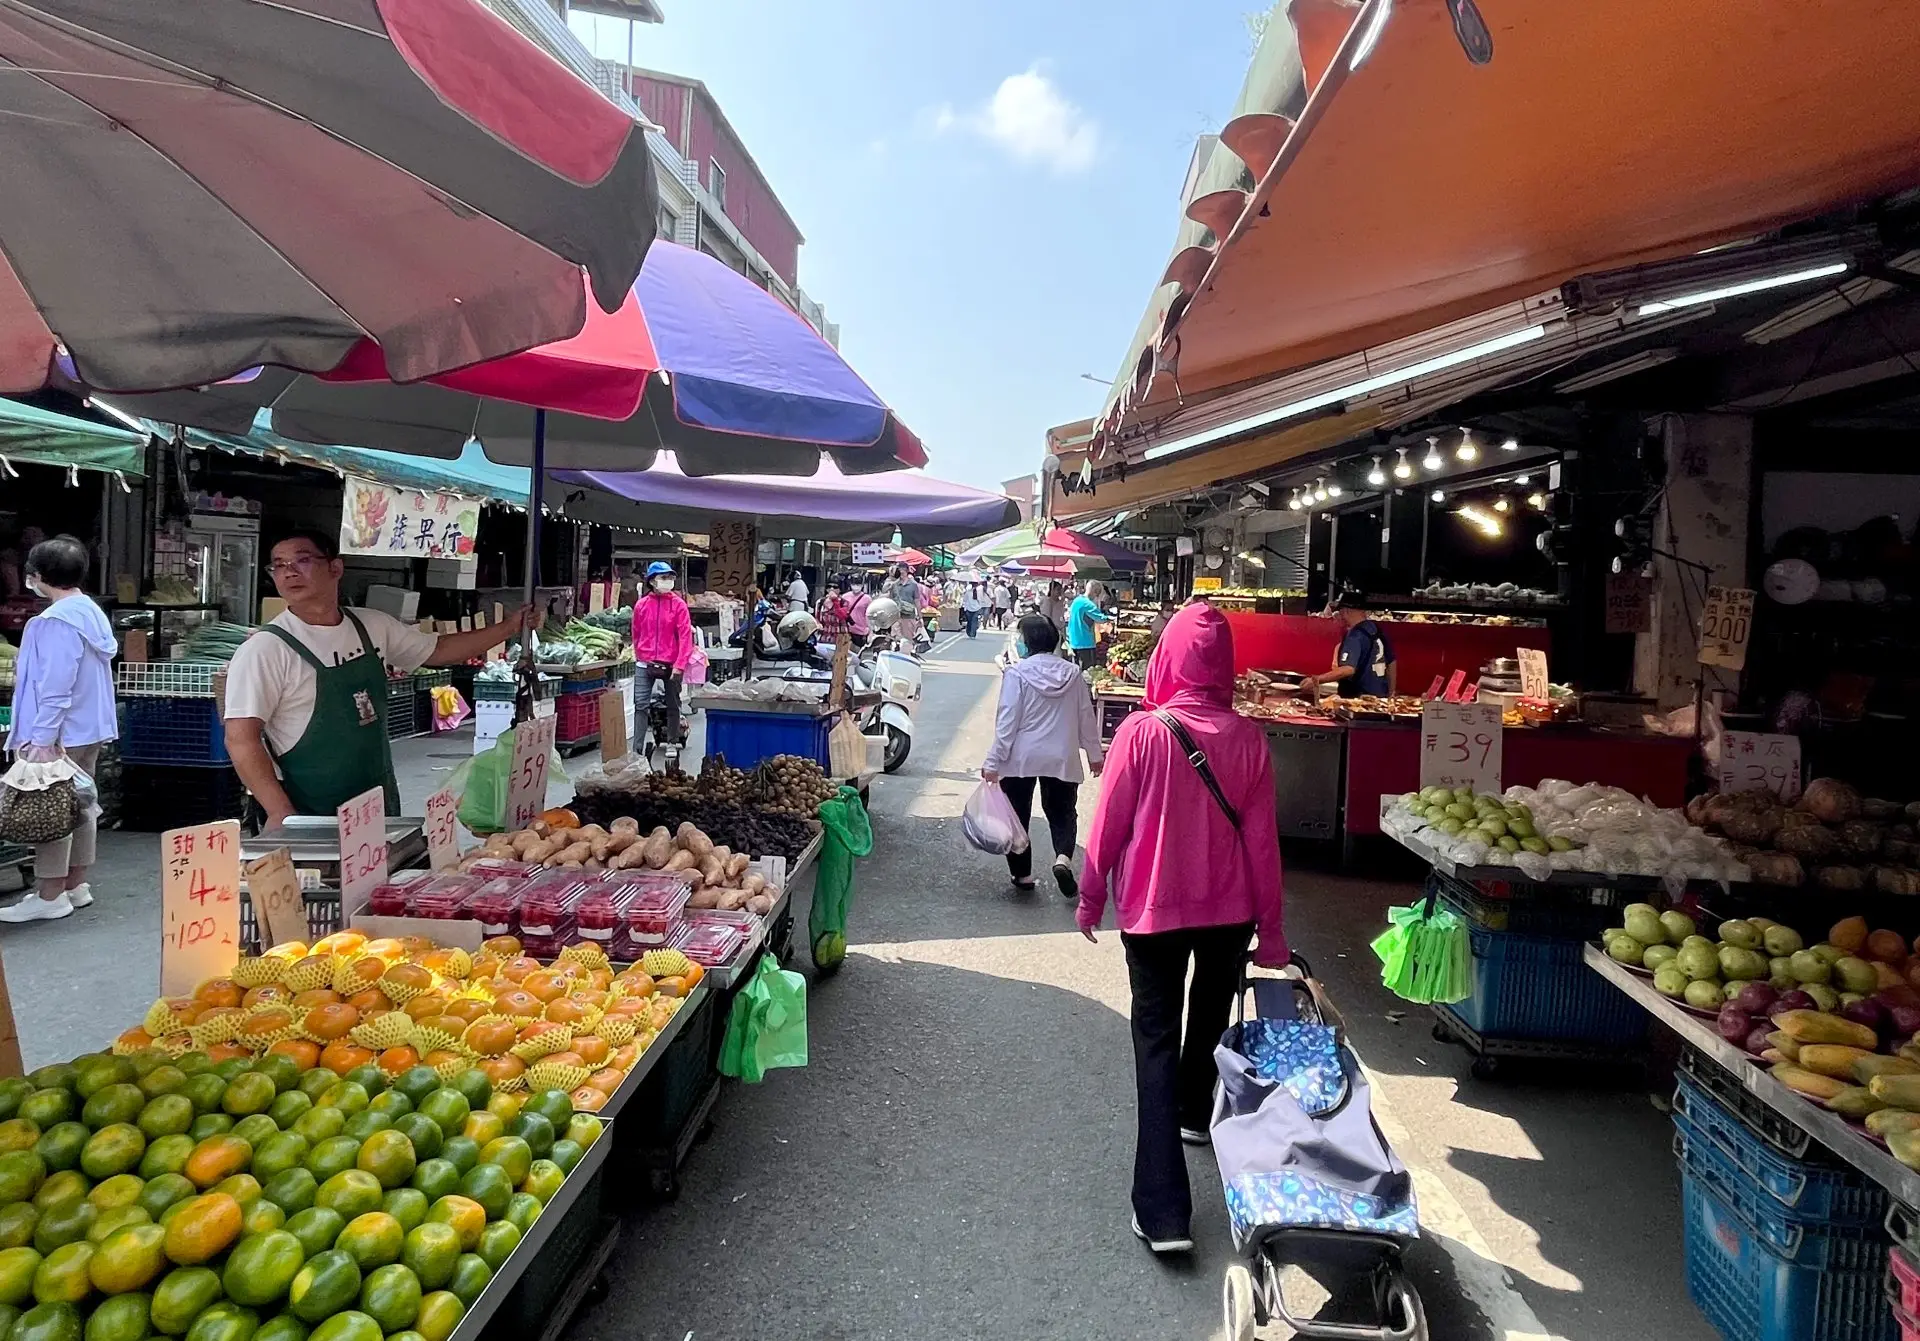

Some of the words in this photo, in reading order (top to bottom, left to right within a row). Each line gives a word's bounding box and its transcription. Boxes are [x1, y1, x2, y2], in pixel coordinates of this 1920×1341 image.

[389, 514, 462, 554] 蔬果行
[1703, 615, 1746, 644] 200
[1526, 675, 1542, 699] 50
[1448, 731, 1493, 769] 39
[523, 753, 545, 790] 59
[173, 830, 228, 855] 甜柿
[437, 810, 455, 846] 39
[359, 842, 388, 878] 200
[190, 868, 216, 906] 4
[179, 917, 216, 949] 100
